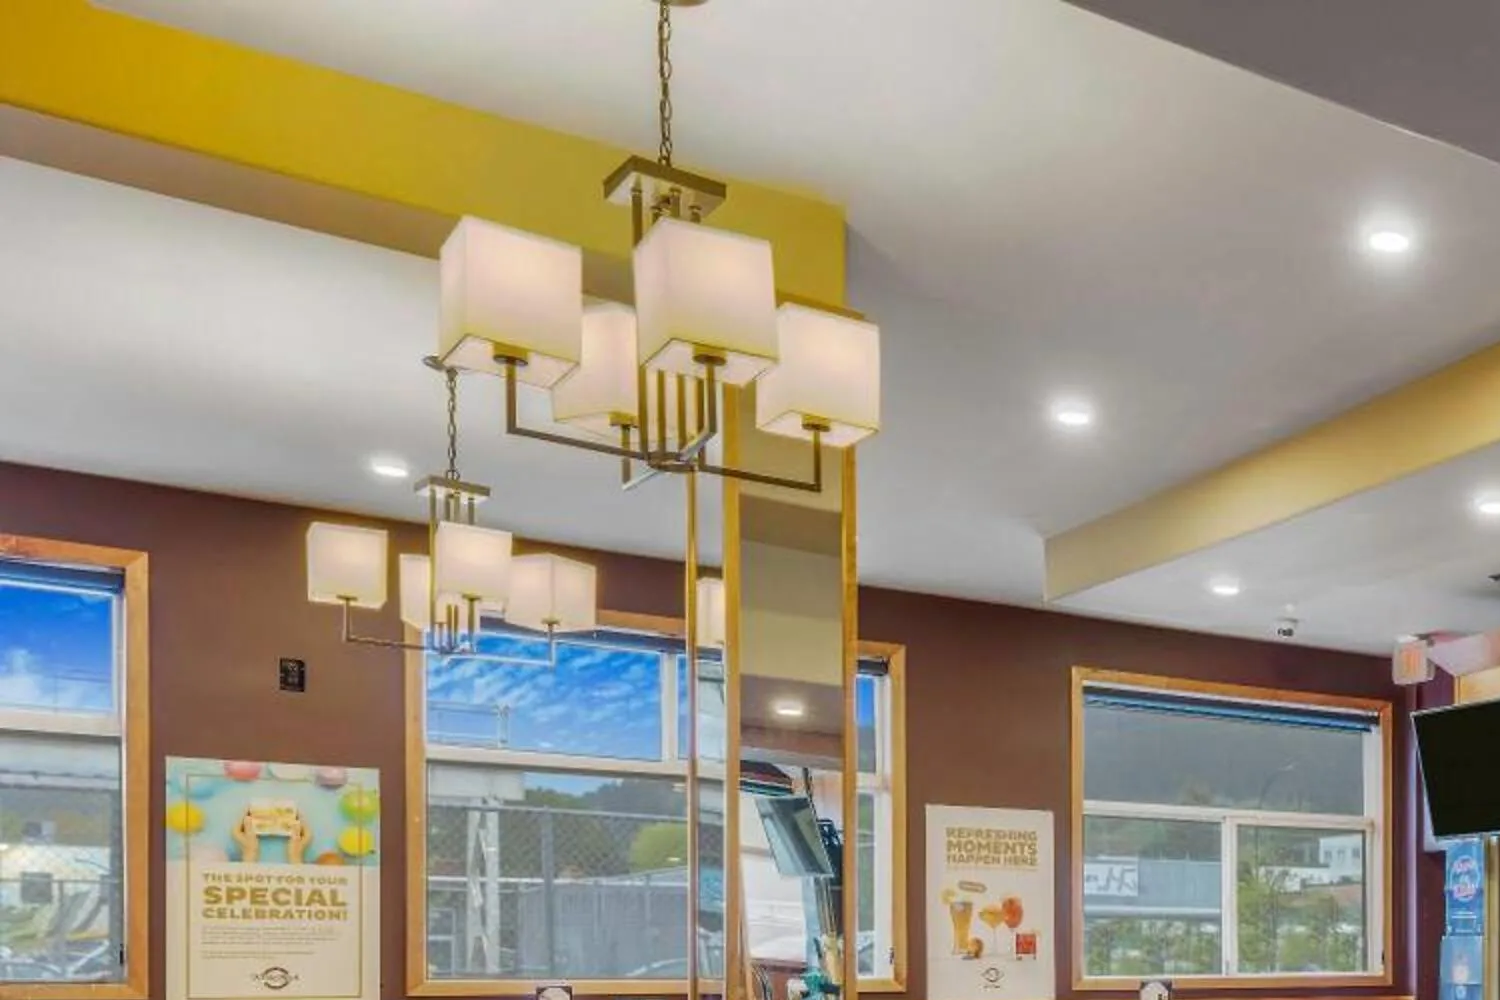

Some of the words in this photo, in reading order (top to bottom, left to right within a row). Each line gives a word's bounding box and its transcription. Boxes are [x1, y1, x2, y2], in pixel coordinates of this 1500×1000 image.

[946, 839, 1037, 855] MOMENTS
[203, 872, 232, 883] THE
[309, 876, 348, 886] YOUR
[203, 885, 347, 907] SPECIAL
[202, 907, 348, 921] CELEBRATION!
